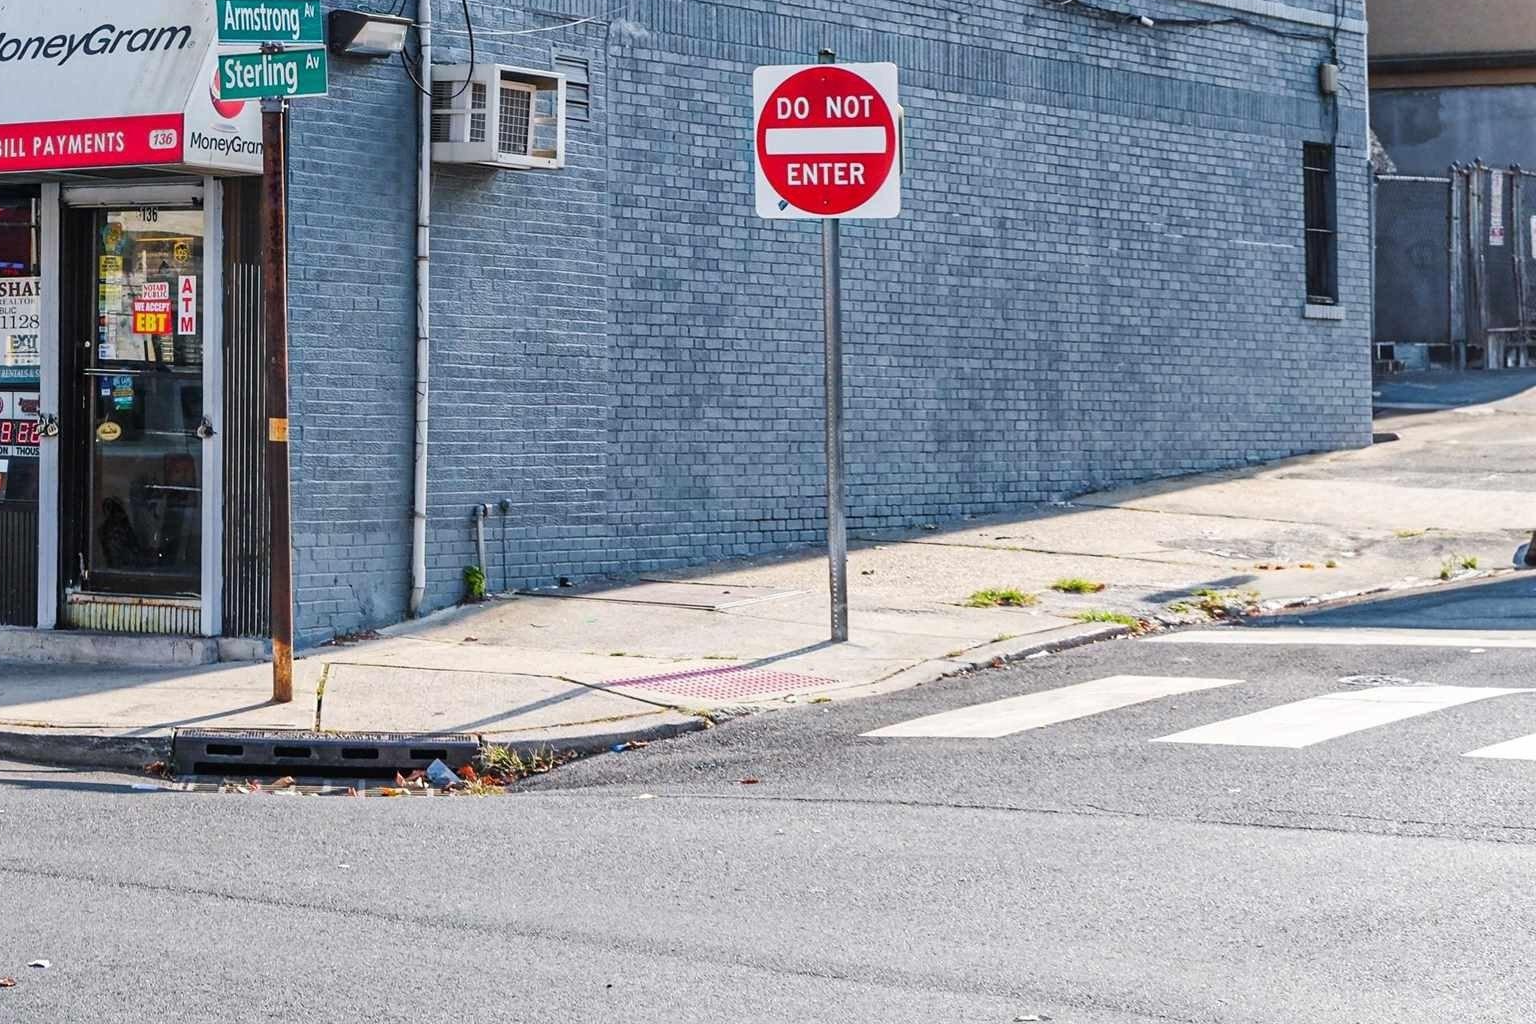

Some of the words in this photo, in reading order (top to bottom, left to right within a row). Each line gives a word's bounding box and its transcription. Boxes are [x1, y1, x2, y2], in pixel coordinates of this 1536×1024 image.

[224, 0, 300, 40] Armstrong
[304, 2, 314, 18] Av
[224, 55, 298, 93] Sterling
[306, 54, 320, 70] Av
[776, 96, 810, 120] DO
[826, 95, 874, 119] NOT
[32, 131, 126, 157] PAYMENTS
[152, 132, 174, 145] 136
[787, 162, 865, 186] ENTER
[141, 207, 158, 222] 136
[181, 278, 193, 332] ATM
[136, 313, 168, 332] EBT
